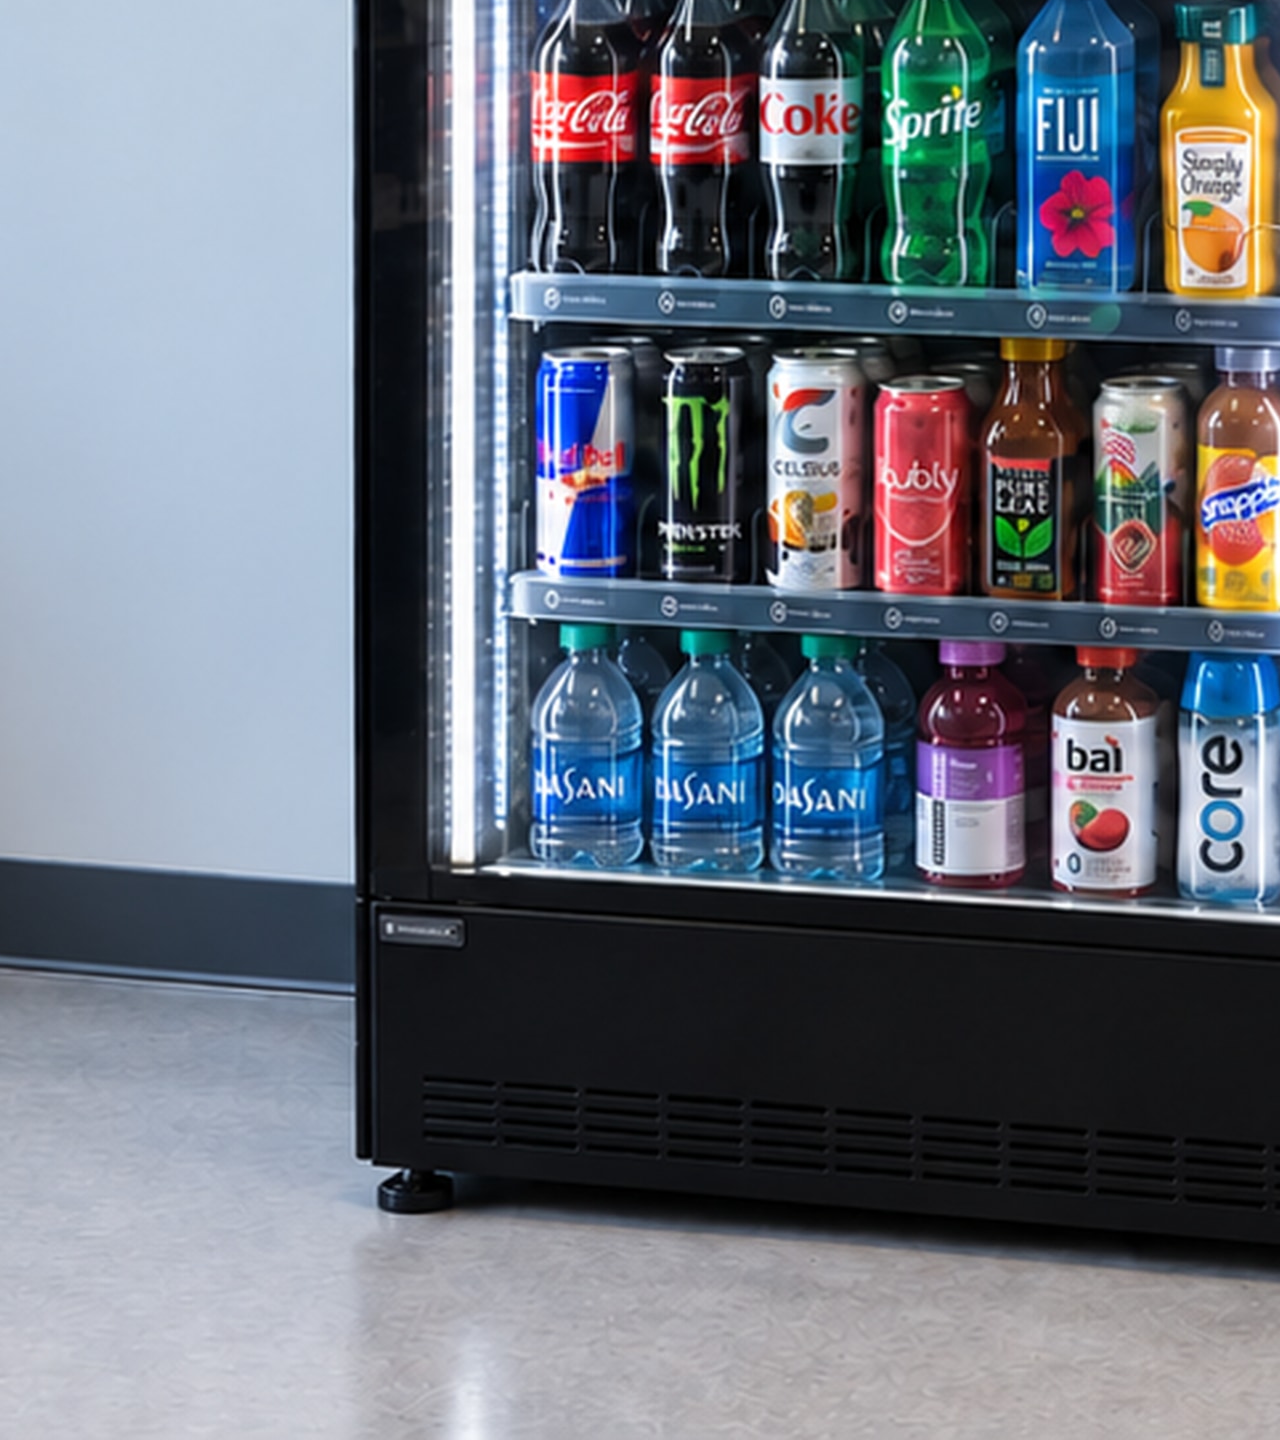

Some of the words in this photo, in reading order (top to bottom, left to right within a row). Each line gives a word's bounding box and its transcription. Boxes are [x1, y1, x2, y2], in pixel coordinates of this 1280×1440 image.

[760, 92, 859, 135] Coke
[884, 91, 982, 150] Sprite
[1037, 98, 1098, 153] FIJI
[1067, 735, 1123, 773] bai
[1199, 735, 1244, 873] core
